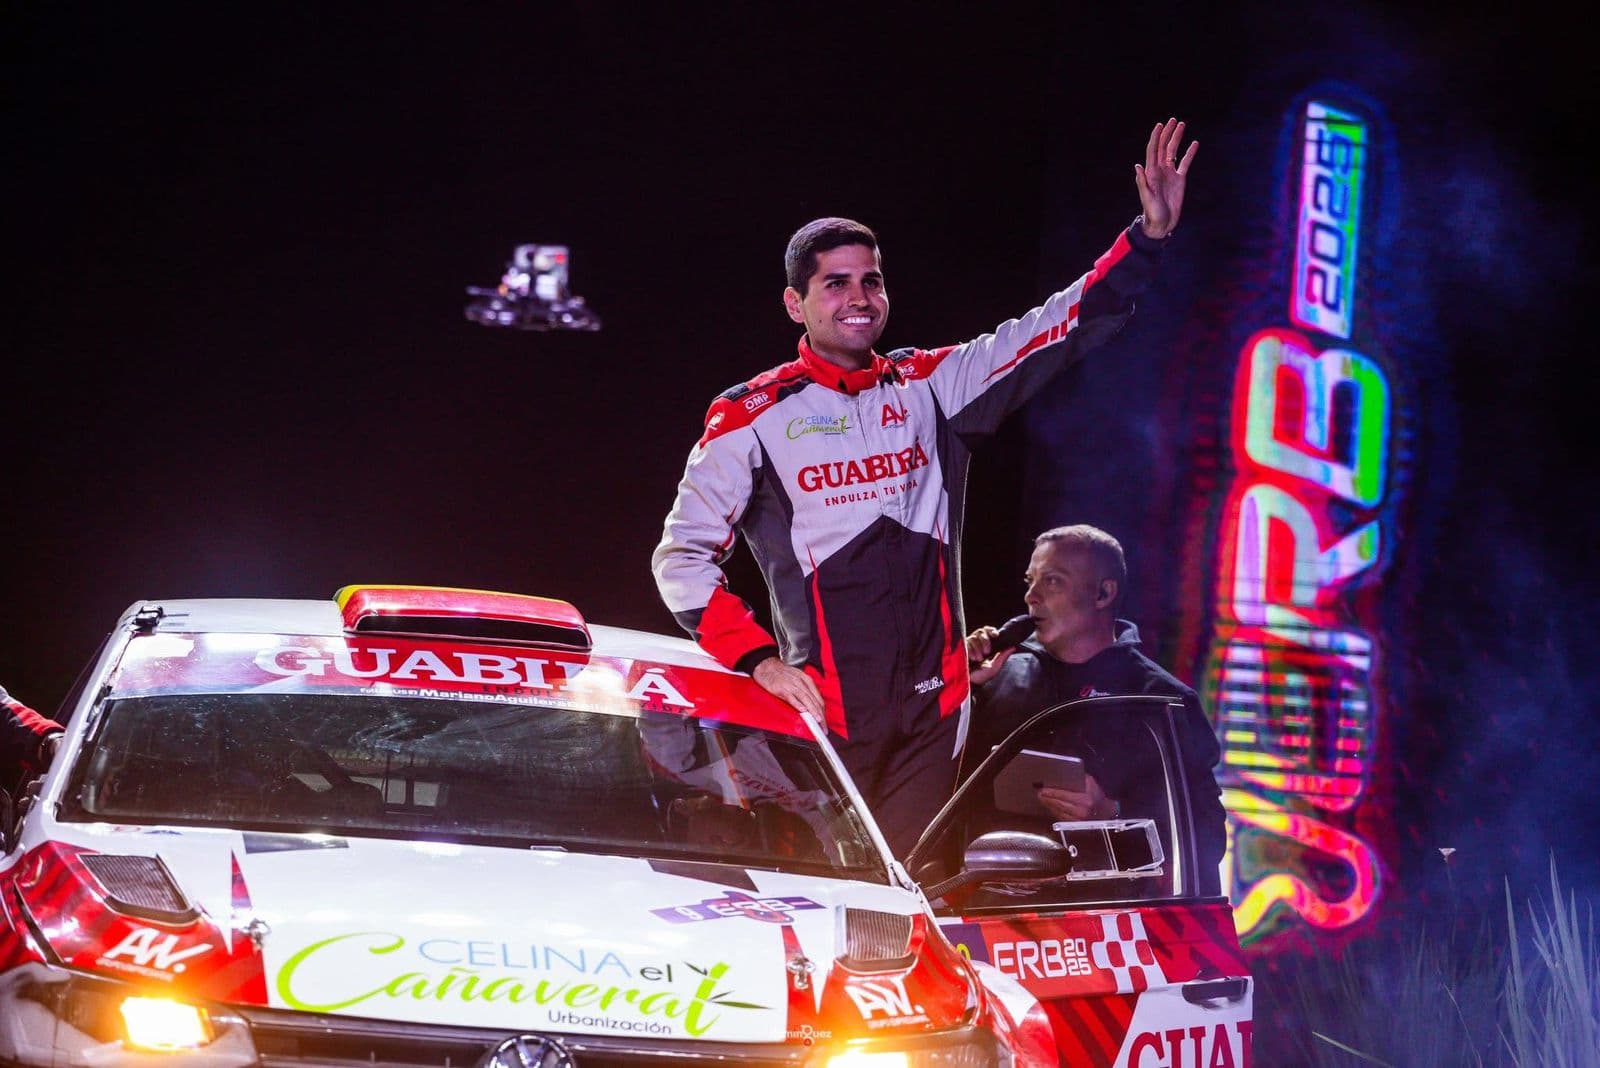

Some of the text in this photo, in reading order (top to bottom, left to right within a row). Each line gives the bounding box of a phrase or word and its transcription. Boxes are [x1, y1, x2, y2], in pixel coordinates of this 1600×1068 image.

[1305, 128, 1353, 314] 2025
[745, 393, 769, 410] OMP
[805, 416, 834, 425] CELINA
[797, 435, 929, 492] GUABIRÁ
[825, 491, 877, 506] ENDULZA
[883, 486, 896, 496] TU
[706, 899, 795, 917] ERB
[419, 938, 673, 982] CELINA el
[993, 939, 1067, 980] ERB
[1063, 938, 1087, 957] 20
[1066, 958, 1092, 976] 25
[276, 931, 730, 1036] Cañaveral
[547, 1009, 672, 1035] Urbanización
